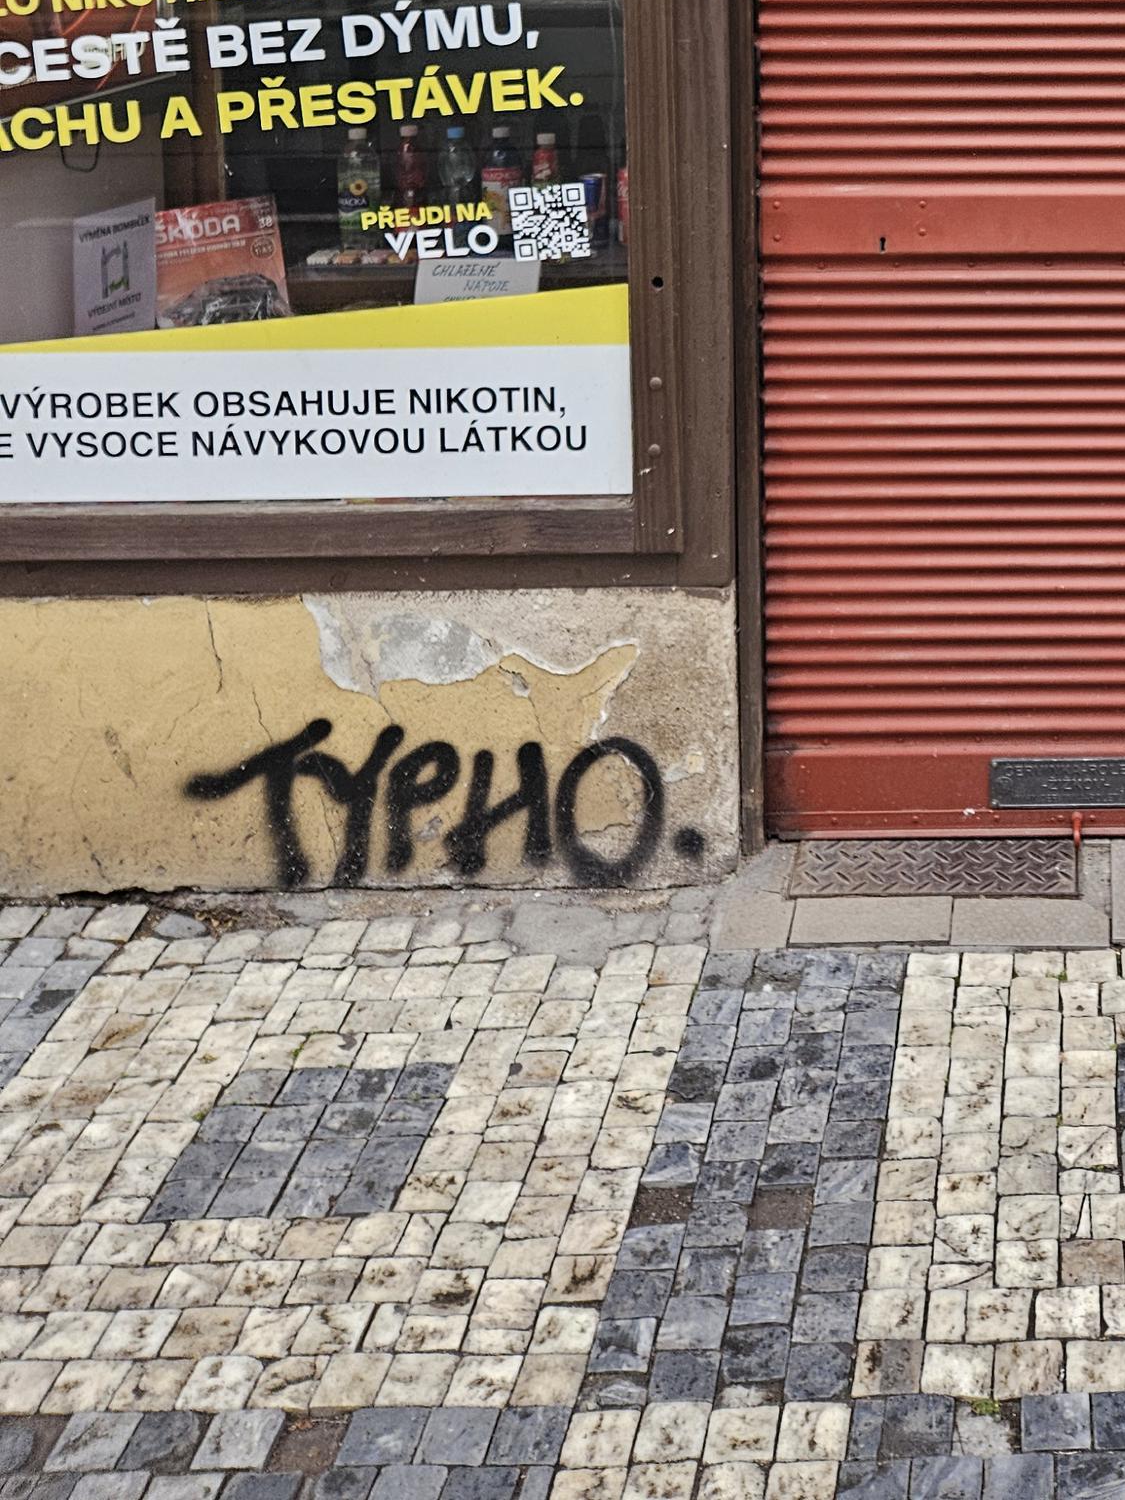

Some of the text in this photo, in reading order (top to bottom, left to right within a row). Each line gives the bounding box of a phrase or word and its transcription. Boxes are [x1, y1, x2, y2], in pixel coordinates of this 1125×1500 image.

[0, 0, 540, 86] CESTĚ BEZ DÝMU,
[160, 96, 203, 139] A
[216, 65, 584, 134] PŘESTÁVEK.
[360, 202, 494, 231] PŘEJDI NA
[384, 224, 499, 261] VELO
[0, 386, 567, 419] VÝROBEK OBSAHUJE NIKOTIN,
[26, 431, 179, 458] VYSOCE
[192, 423, 425, 457] NÁVYKOVOU
[440, 419, 587, 453] LÁTKOU
